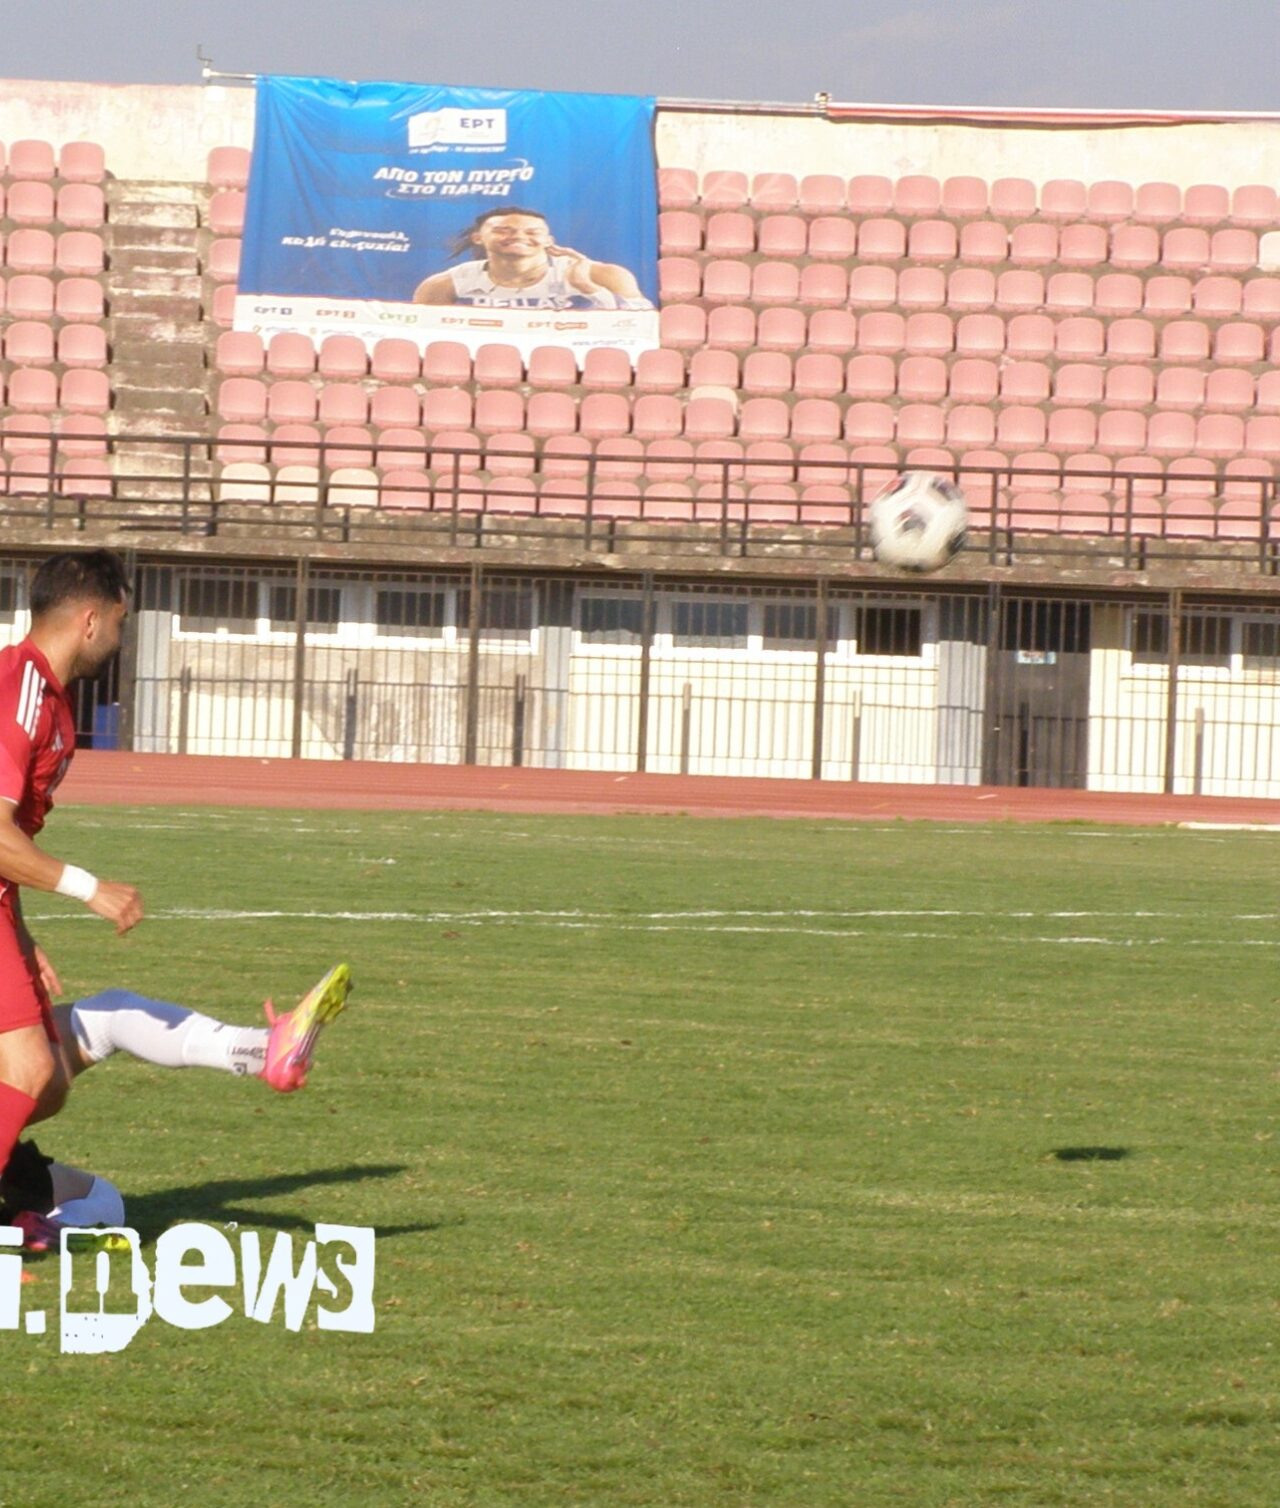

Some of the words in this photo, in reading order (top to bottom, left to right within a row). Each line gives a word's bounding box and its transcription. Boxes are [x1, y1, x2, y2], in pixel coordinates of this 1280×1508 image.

[460, 117, 495, 129] ΕΡΤ
[374, 167, 418, 182] ΑΠΟ
[423, 169, 464, 183] ΤΟΝ
[468, 166, 535, 182] ΠΥΡΓΟ
[398, 184, 436, 194] ΣΤΟ
